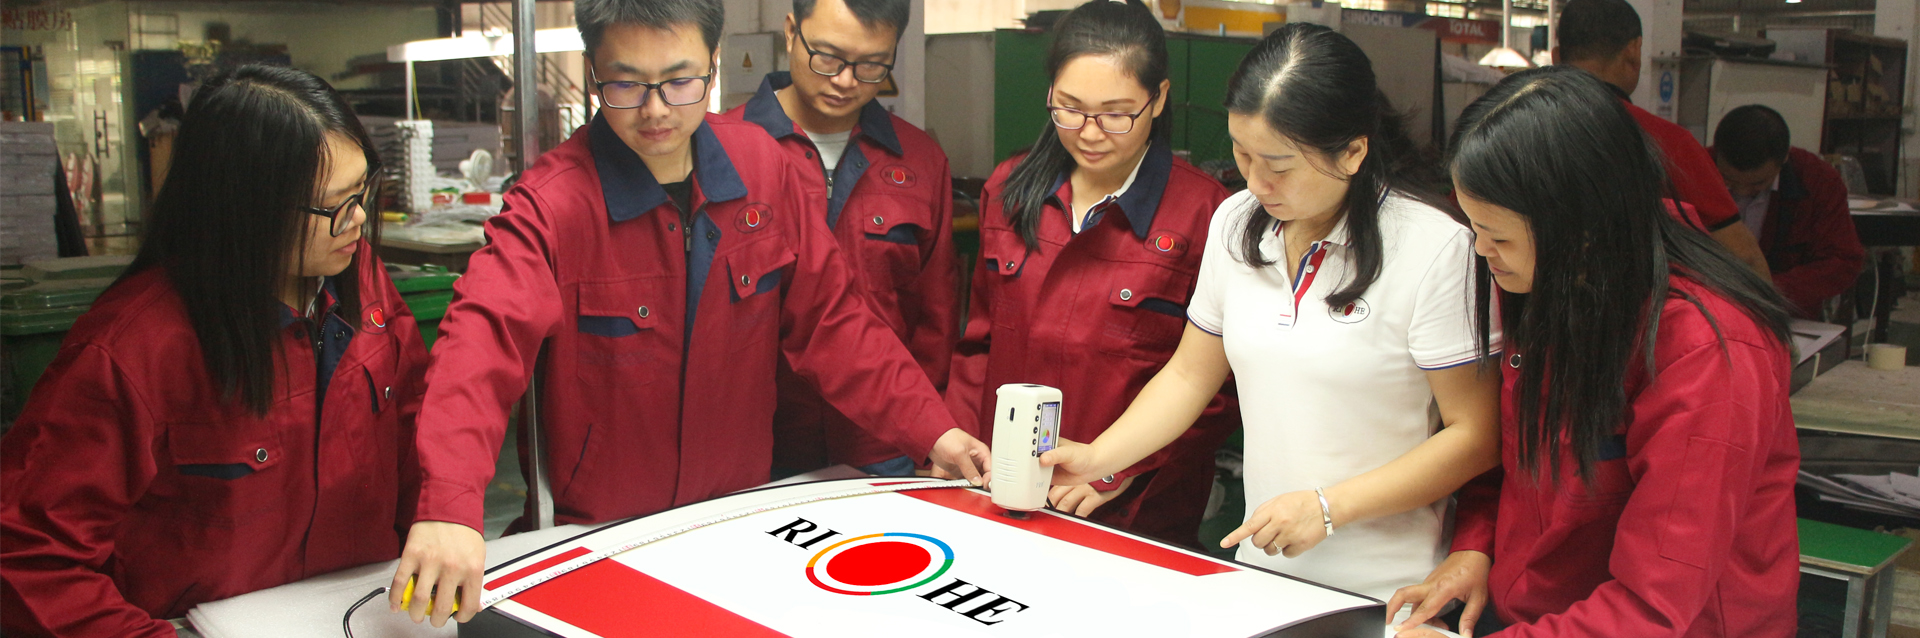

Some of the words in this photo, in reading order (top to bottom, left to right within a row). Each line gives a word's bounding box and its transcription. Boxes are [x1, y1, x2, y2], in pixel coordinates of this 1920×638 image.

[1450, 20, 1485, 37] TOTAL
[1354, 306, 1366, 315] HE
[765, 516, 843, 550] RI
[916, 577, 1030, 626] HE
